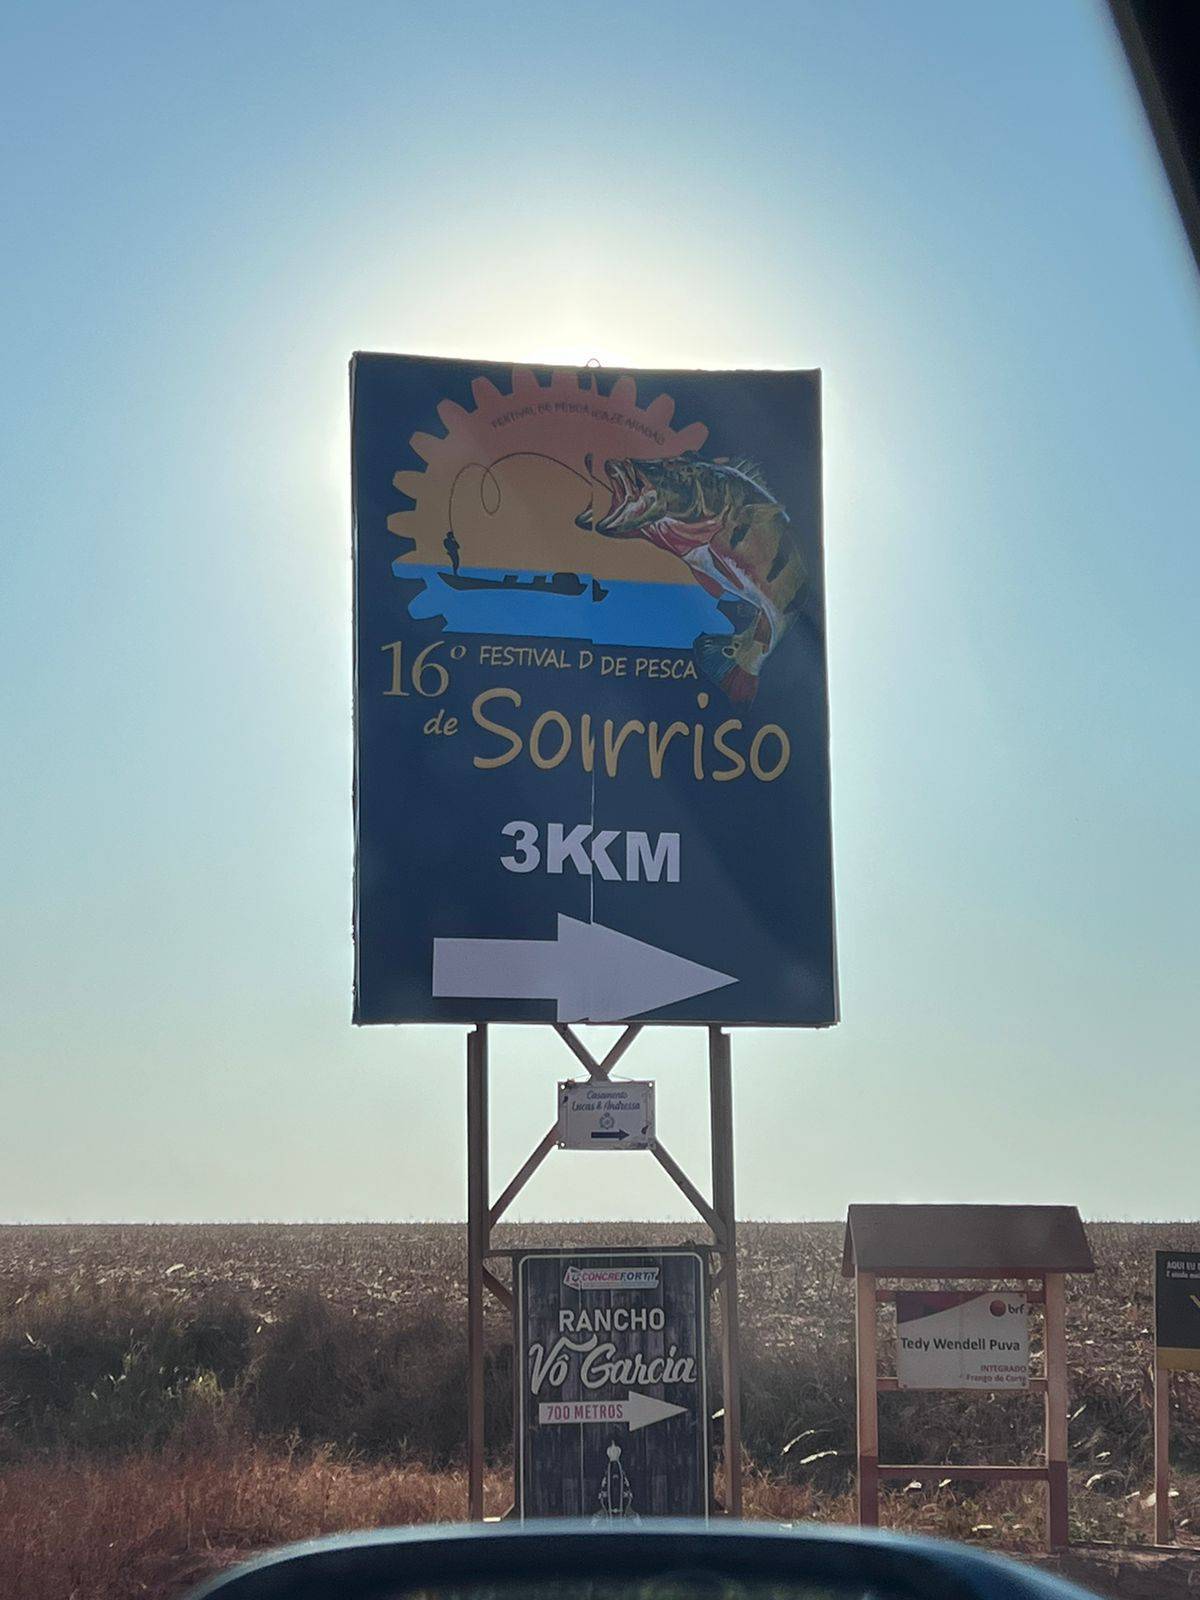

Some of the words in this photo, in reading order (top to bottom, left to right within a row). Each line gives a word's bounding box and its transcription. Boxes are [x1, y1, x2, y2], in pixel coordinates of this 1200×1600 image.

[479, 644, 571, 669] FESTIVAL
[600, 655, 628, 676] DE
[635, 657, 699, 680] PESCA
[423, 708, 459, 736] de
[586, 1090, 629, 1100] Casamento
[571, 1100, 595, 1111] Lucas
[1008, 1302, 1025, 1314] brf
[558, 1308, 666, 1333] RANCHO
[900, 1337, 931, 1352] Tedy
[933, 1338, 987, 1351] Wendell
[989, 1339, 1021, 1351] Puva
[528, 1334, 598, 1396] Vô
[580, 1342, 697, 1390] Garcia
[980, 1365, 1028, 1374] INTEGRADO
[547, 1405, 570, 1421] 700
[574, 1404, 624, 1421] METROS
